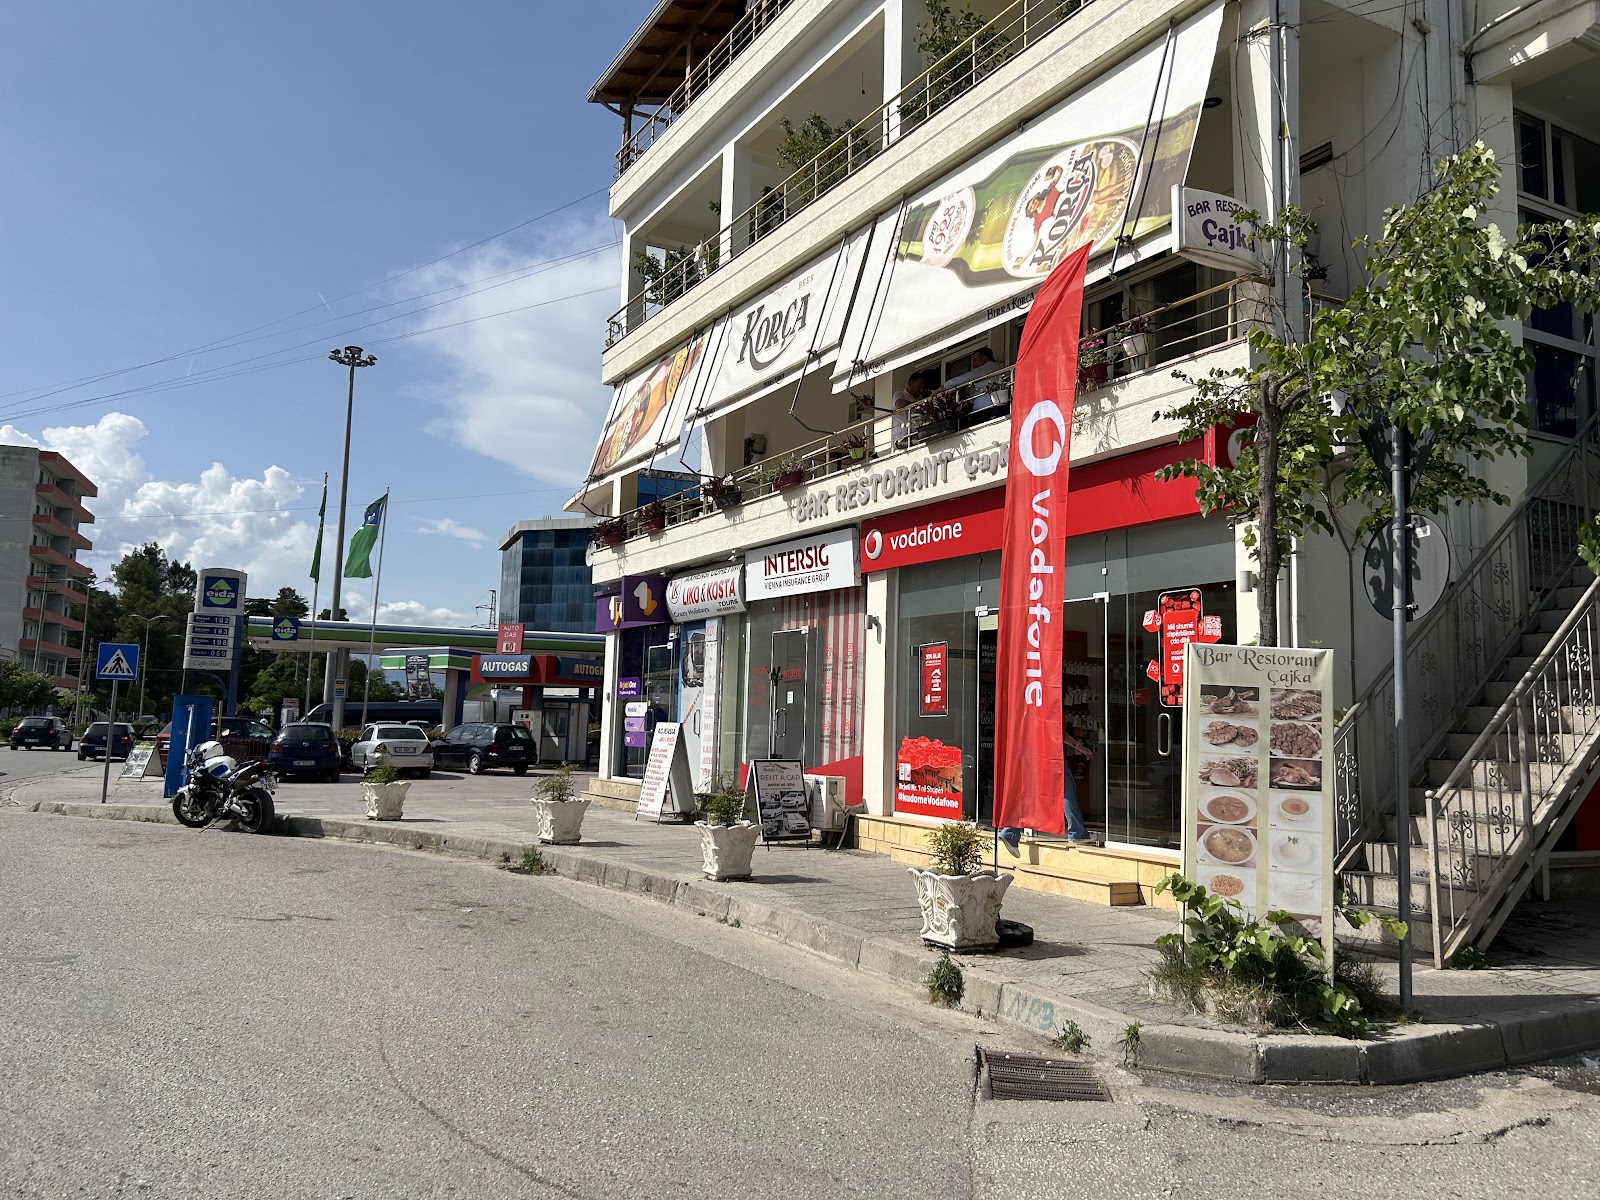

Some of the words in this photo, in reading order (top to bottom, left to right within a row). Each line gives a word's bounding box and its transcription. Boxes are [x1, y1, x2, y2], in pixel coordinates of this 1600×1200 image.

[1029, 151, 1094, 267] KORÇA
[1187, 200, 1211, 218] BAR
[933, 205, 956, 254] 1928
[987, 301, 1013, 321] BIRRA
[736, 293, 811, 371] KORÇA
[796, 490, 829, 523] BAR
[835, 452, 953, 513] RESTORANT
[890, 522, 962, 551] vodafone
[764, 543, 829, 577] INTERSIG
[764, 581, 782, 590] VIENNA
[783, 575, 811, 587] INSURANCE
[811, 572, 829, 583] GROUP
[206, 587, 236, 598] eida
[682, 586, 700, 606] LIKO
[701, 583, 706, 603] &
[707, 577, 736, 601] KOSTA
[1025, 488, 1054, 708] vodafone
[673, 610, 688, 618] Crazy
[688, 607, 710, 615] Holidays
[718, 599, 739, 607] TOURS
[1176, 622, 1194, 630] shumë
[1170, 638, 1179, 646] çdo
[481, 662, 528, 672] AUTOGAS
[1196, 647, 1232, 667] Bar
[1238, 649, 1319, 672] Restorant
[1267, 669, 1312, 687] Çajka
[898, 782, 909, 791] Rrjeti
